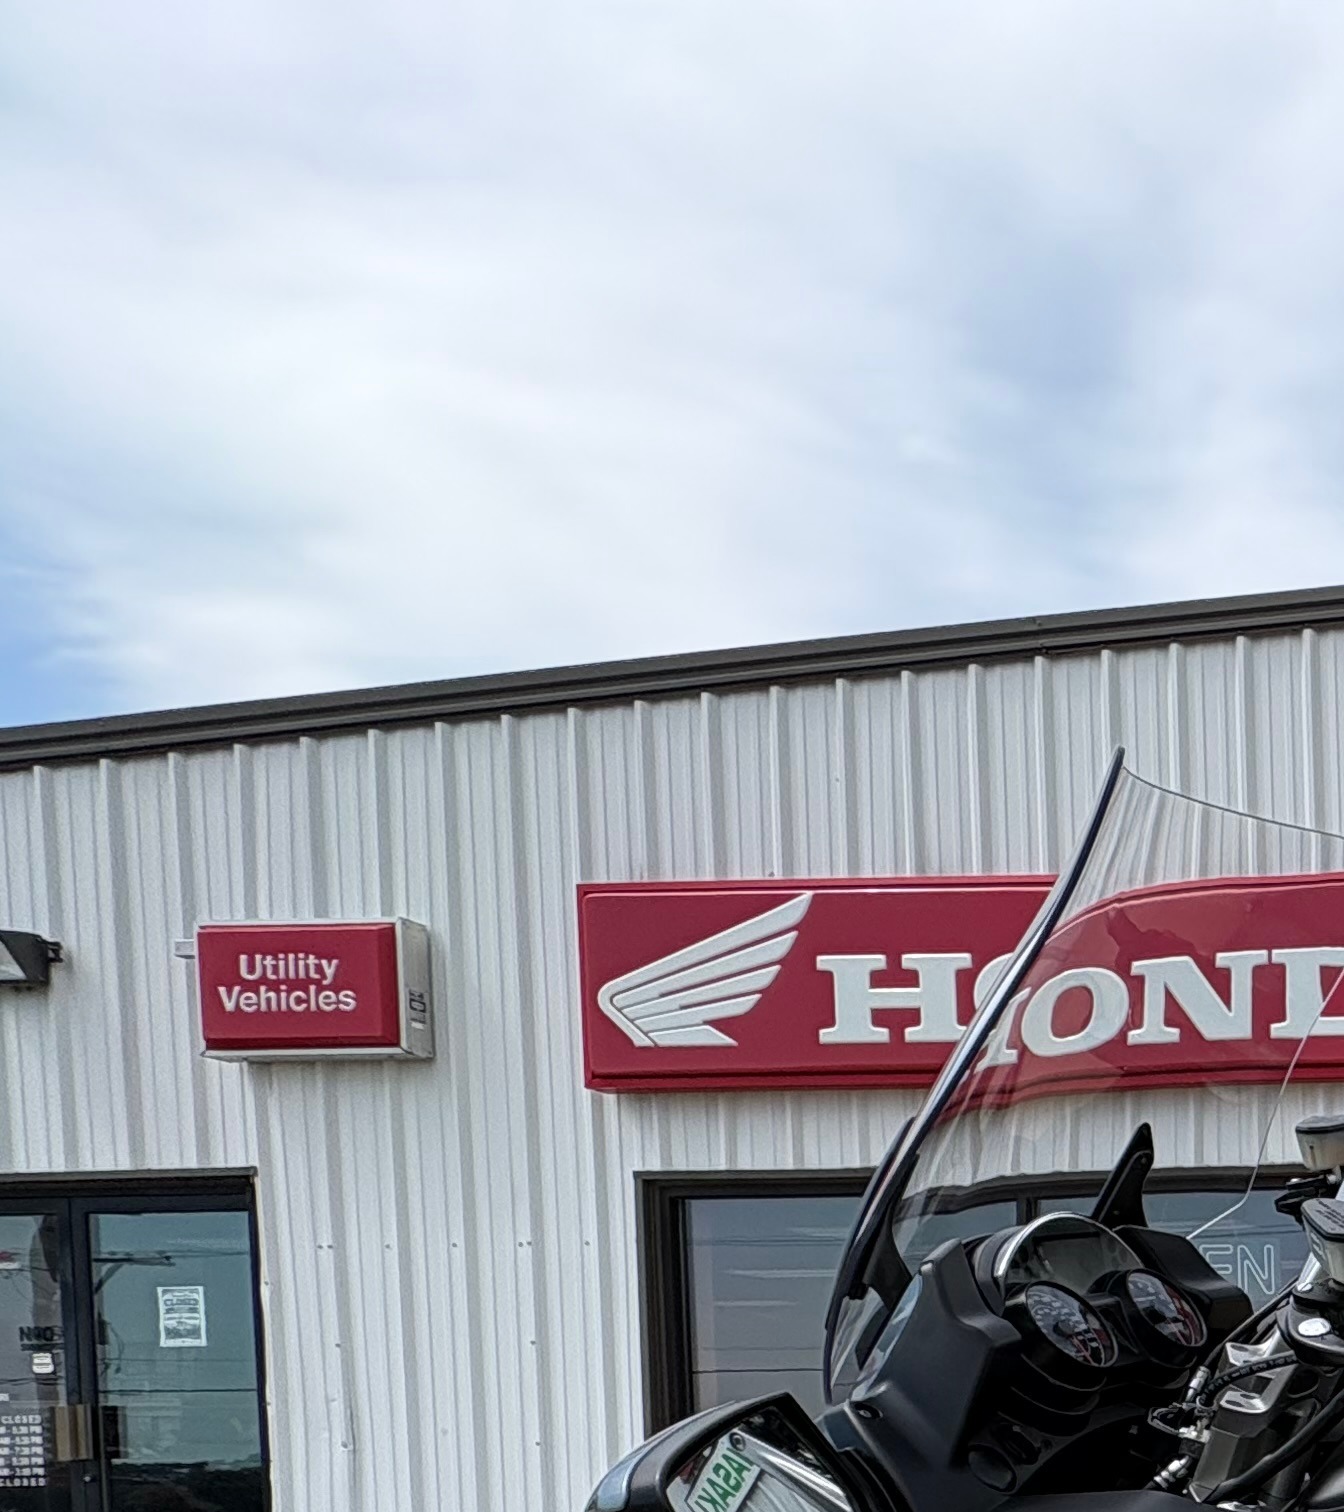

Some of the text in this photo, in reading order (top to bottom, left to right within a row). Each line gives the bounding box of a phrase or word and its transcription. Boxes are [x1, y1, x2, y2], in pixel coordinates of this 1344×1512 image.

[239, 953, 339, 985] Utility
[217, 985, 357, 1012] Vehicles
[1200, 1244, 1275, 1294] EN
